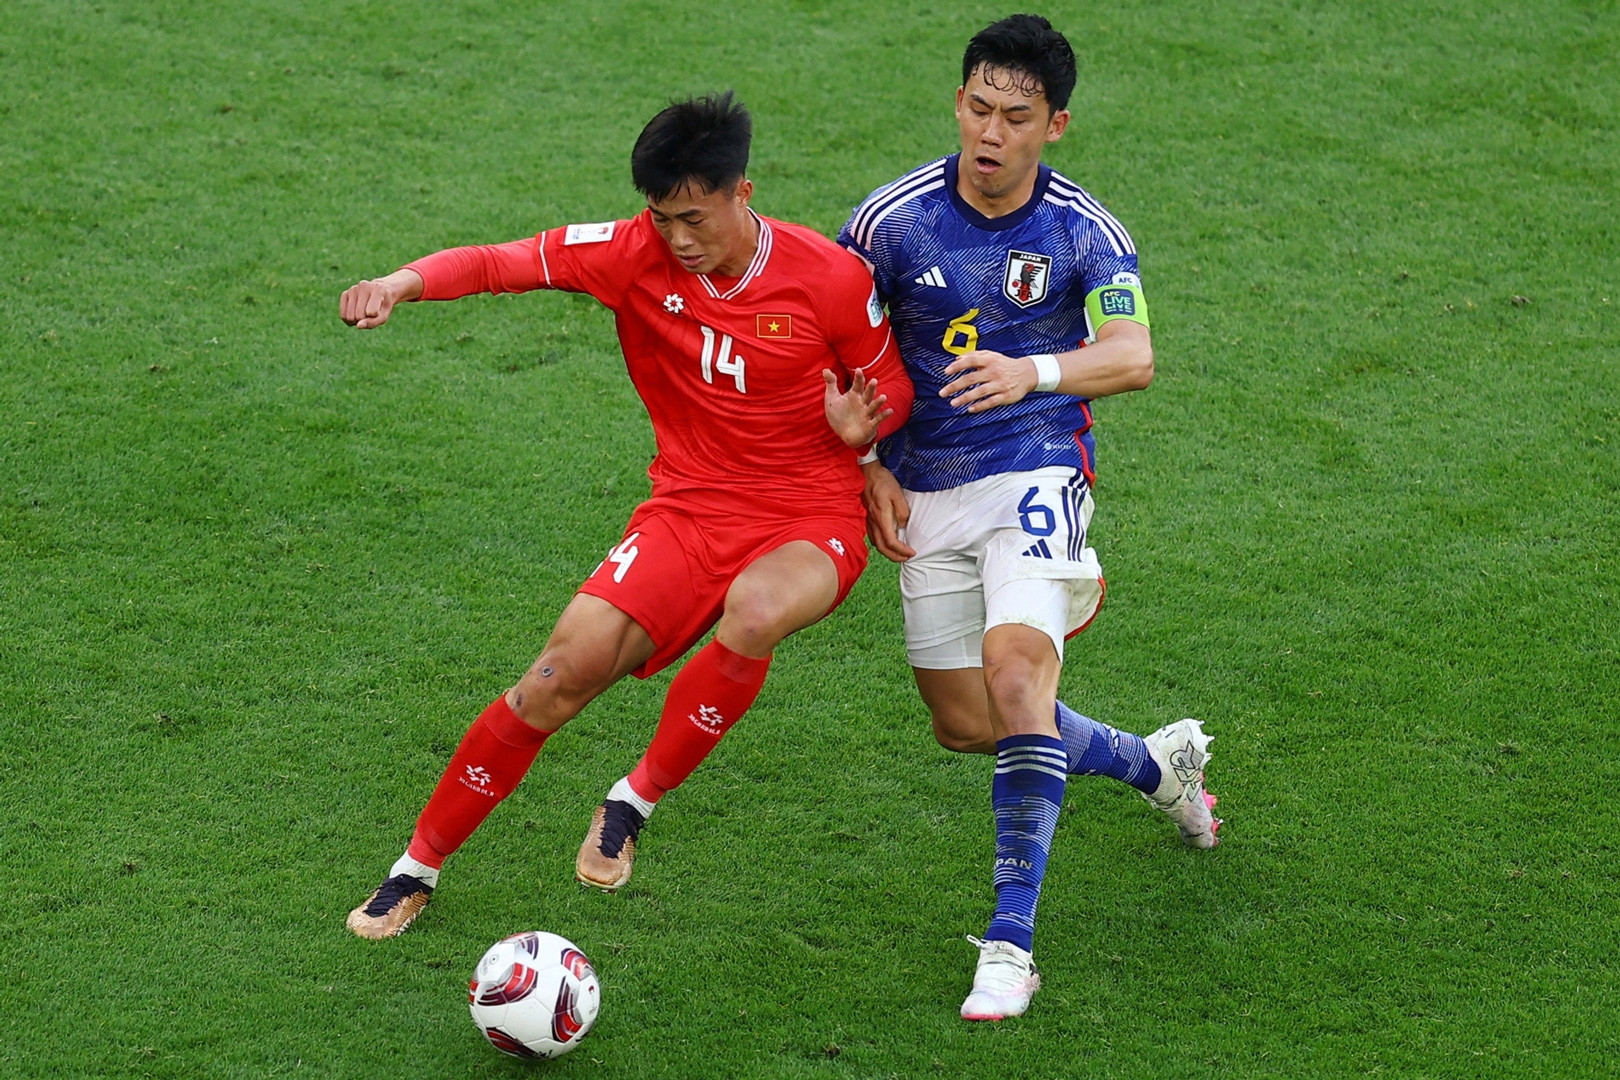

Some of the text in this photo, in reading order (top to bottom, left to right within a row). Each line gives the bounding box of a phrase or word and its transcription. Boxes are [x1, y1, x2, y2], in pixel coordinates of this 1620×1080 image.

[1019, 254, 1042, 262] JAPAN
[1104, 296, 1131, 305] LIVE
[942, 308, 980, 356] 6
[700, 325, 747, 394] 14
[1017, 485, 1057, 537] 6
[994, 857, 1033, 870] PAN
